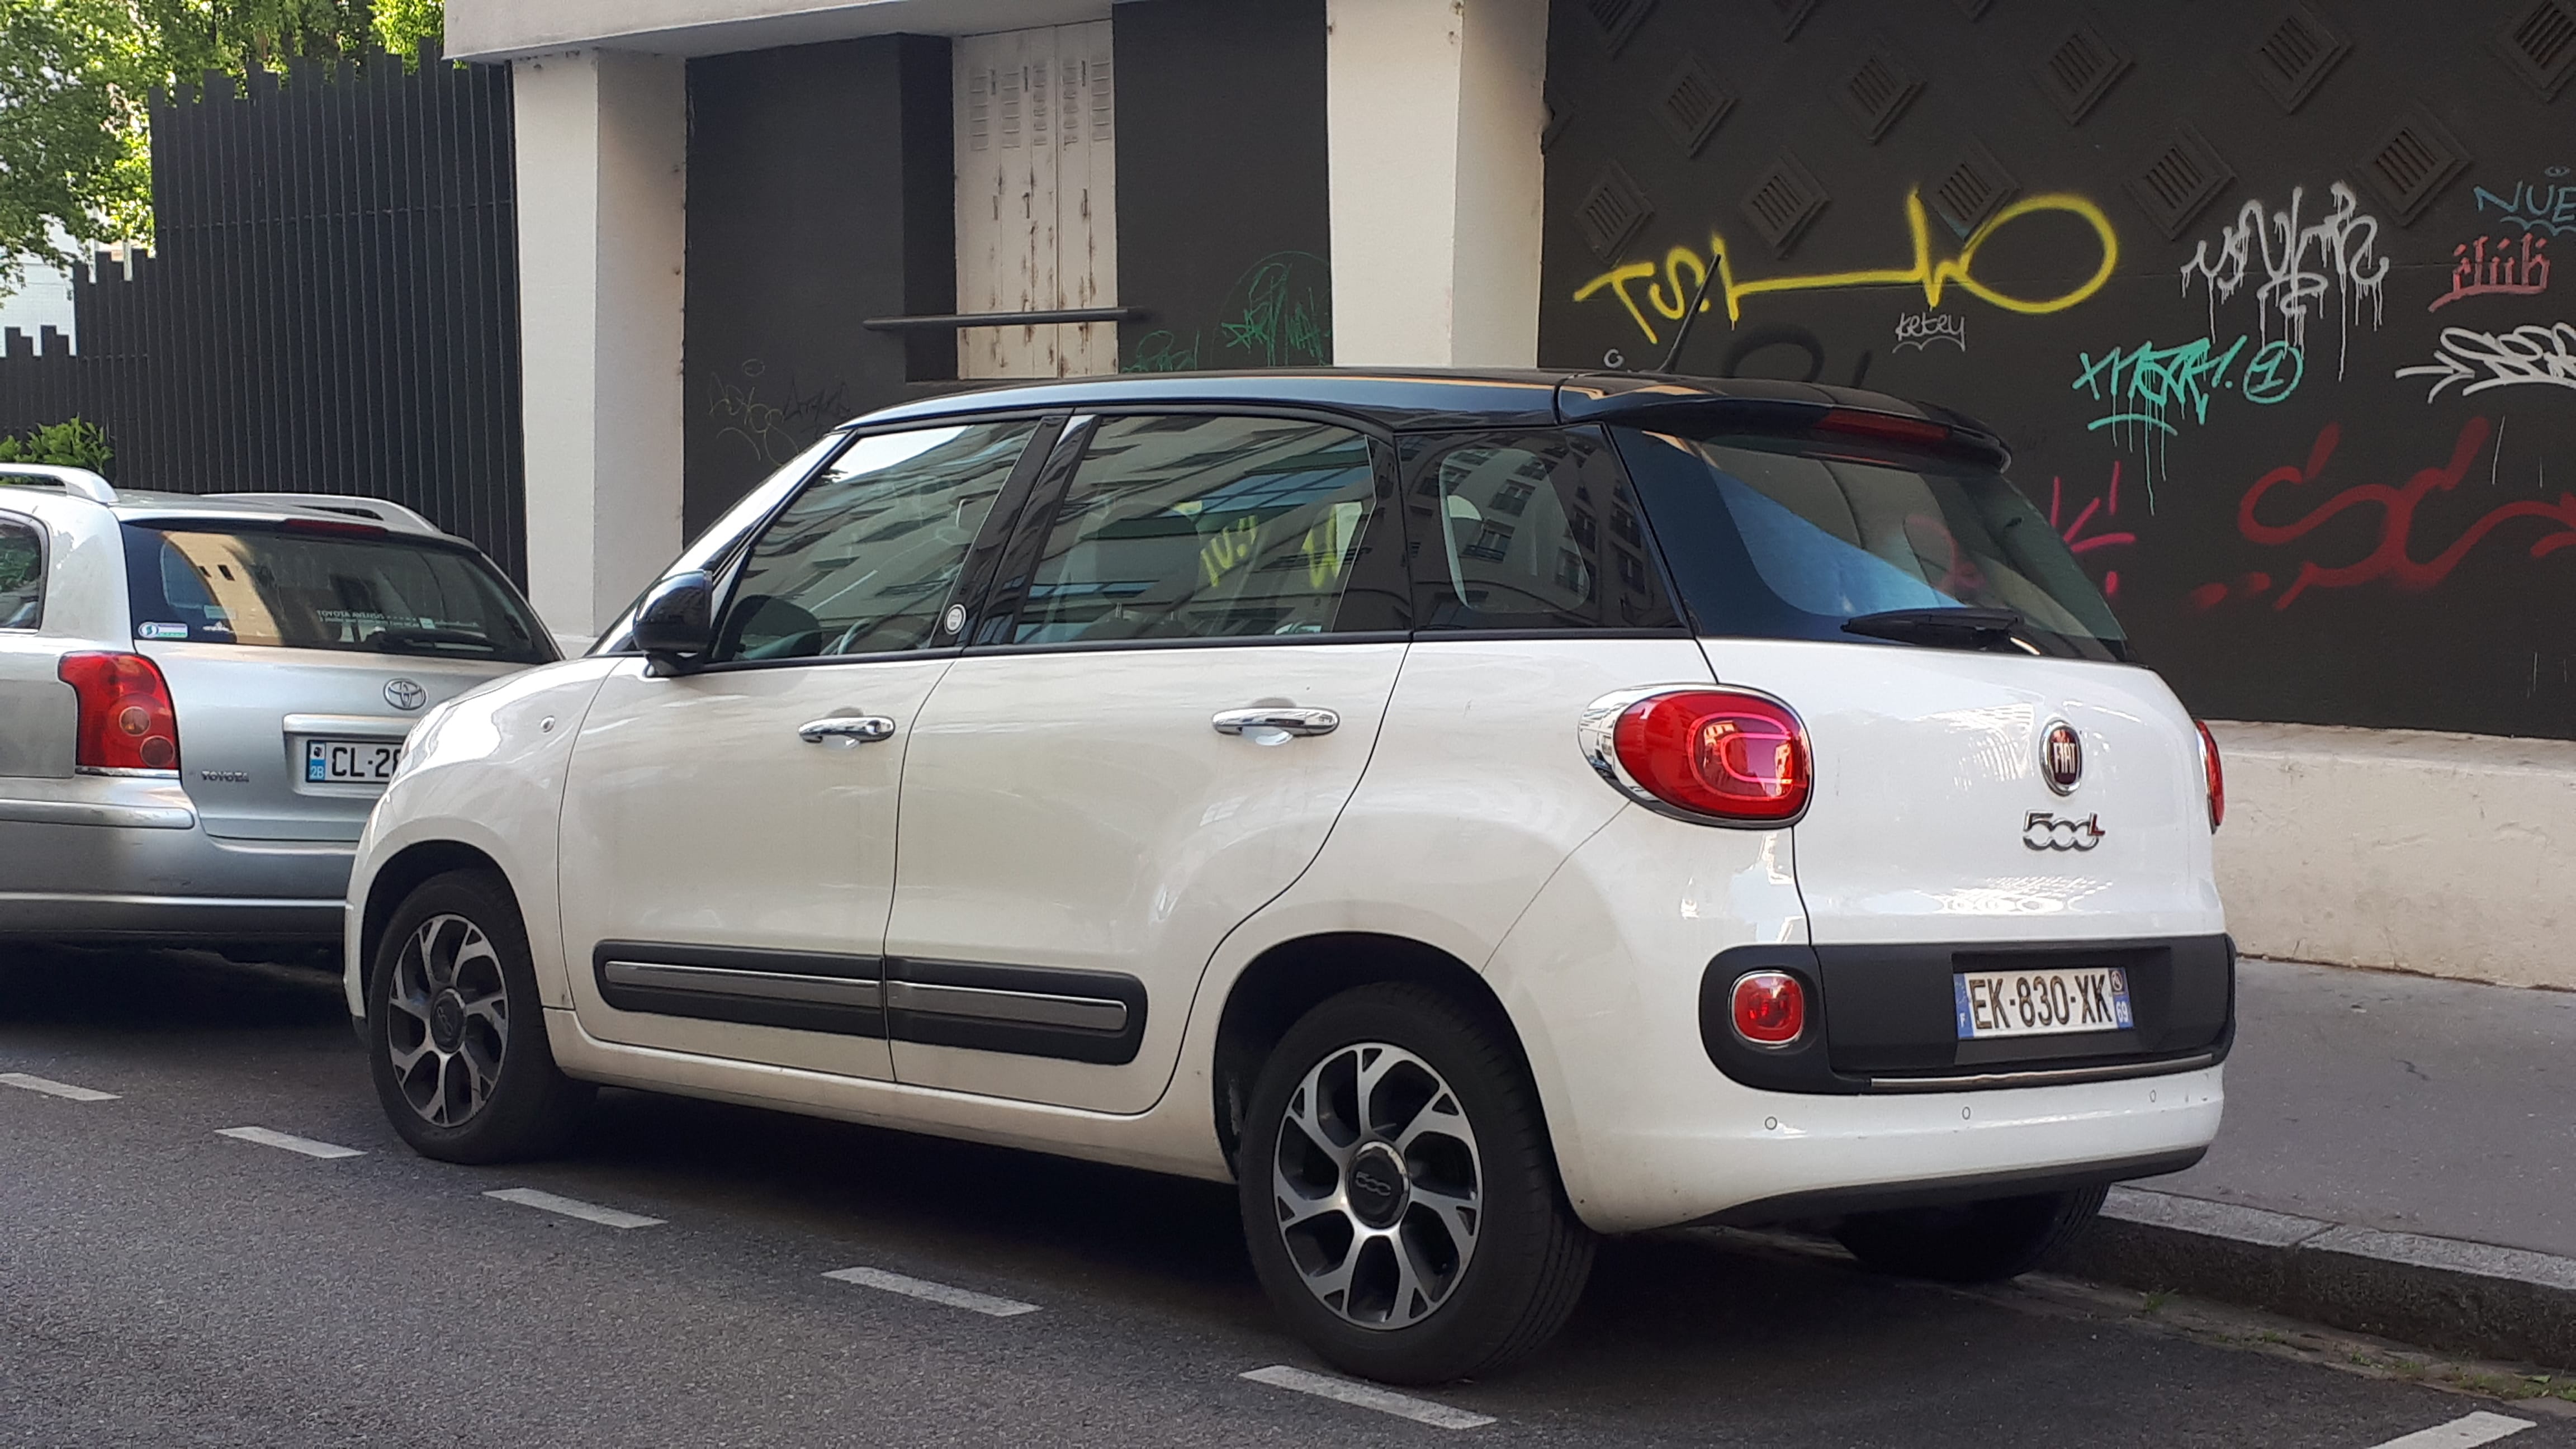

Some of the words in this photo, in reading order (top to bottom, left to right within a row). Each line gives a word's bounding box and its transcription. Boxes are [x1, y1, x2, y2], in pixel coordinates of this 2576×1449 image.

[2053, 742, 2076, 774] FIAT
[201, 770, 250, 783] TOYOTA
[310, 765, 324, 778] 2B
[1968, 974, 2113, 1029] EK-830-XK
[2116, 1001, 2129, 1023] 69
